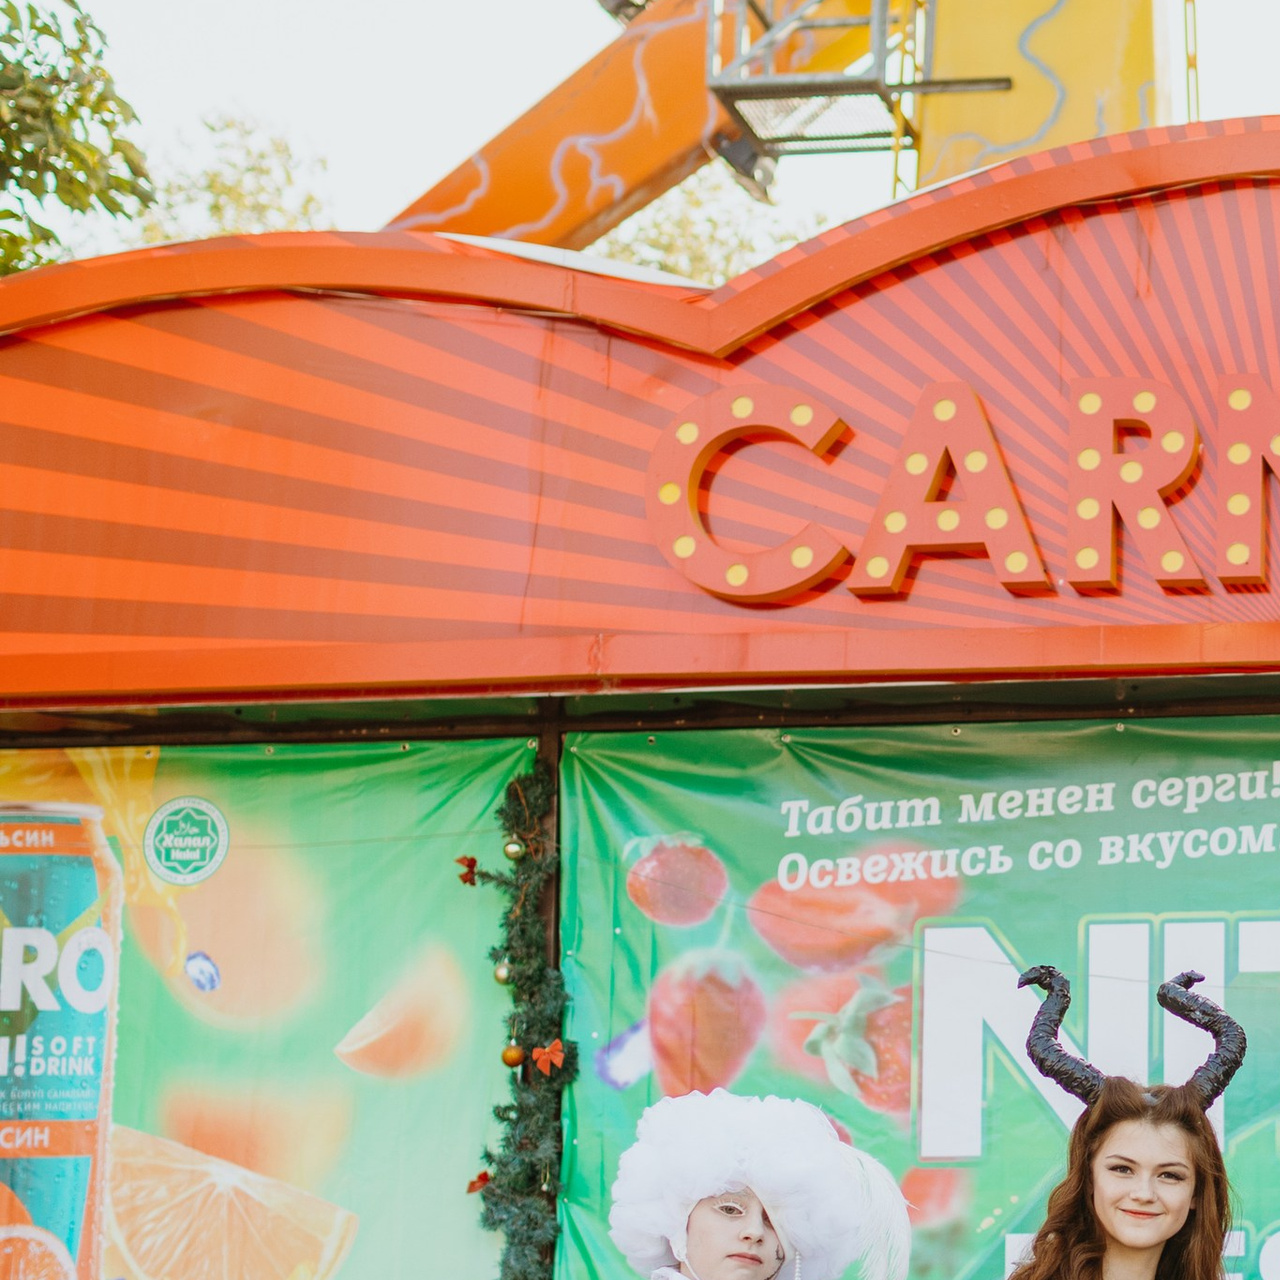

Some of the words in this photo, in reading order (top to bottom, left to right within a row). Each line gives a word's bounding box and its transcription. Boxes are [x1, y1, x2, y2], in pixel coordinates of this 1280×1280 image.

[780, 794, 942, 838] Табит
[957, 781, 1117, 825] менен
[776, 845, 1013, 892] Освежись
[1027, 837, 1082, 871] со
[31, 1035, 97, 1056] SOFT
[29, 1056, 95, 1076] DRINK
